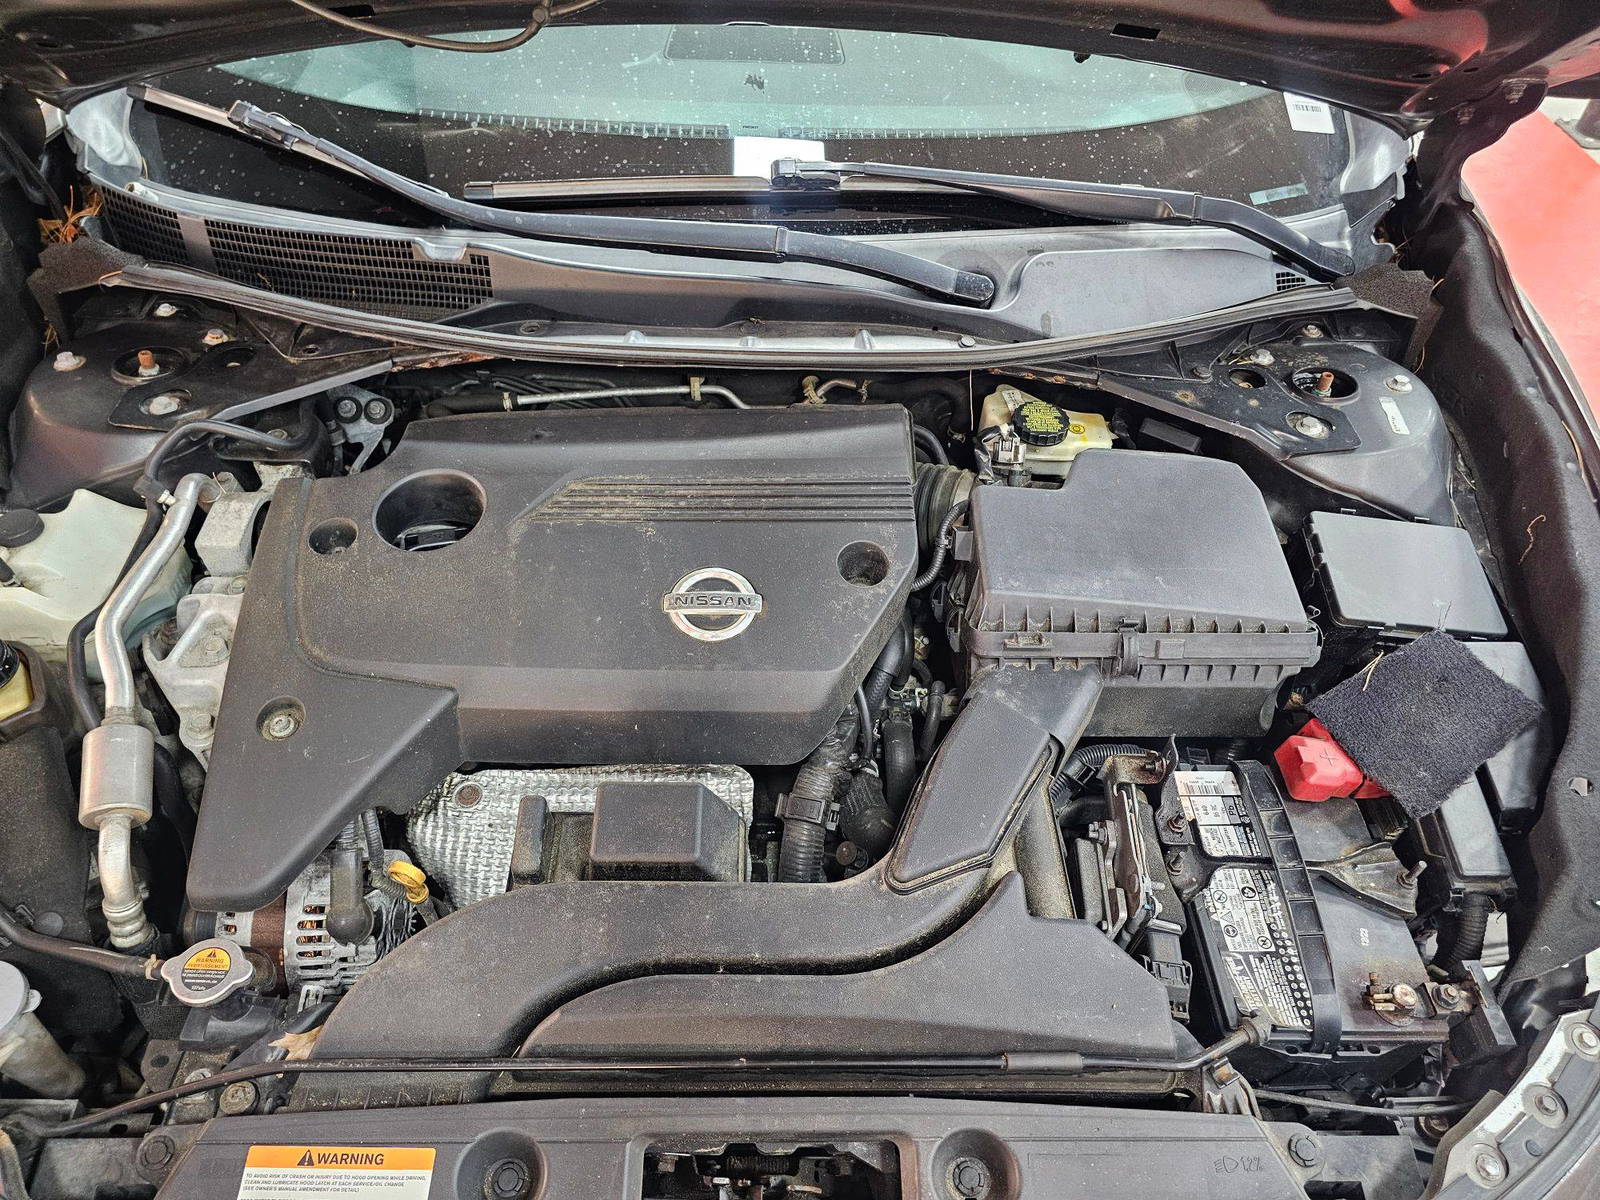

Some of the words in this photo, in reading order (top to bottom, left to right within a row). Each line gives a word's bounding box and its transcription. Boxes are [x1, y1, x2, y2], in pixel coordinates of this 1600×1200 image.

[674, 595, 752, 606] NISSAN
[1227, 805, 1237, 816] Pb
[317, 1153, 385, 1166] WARNING
